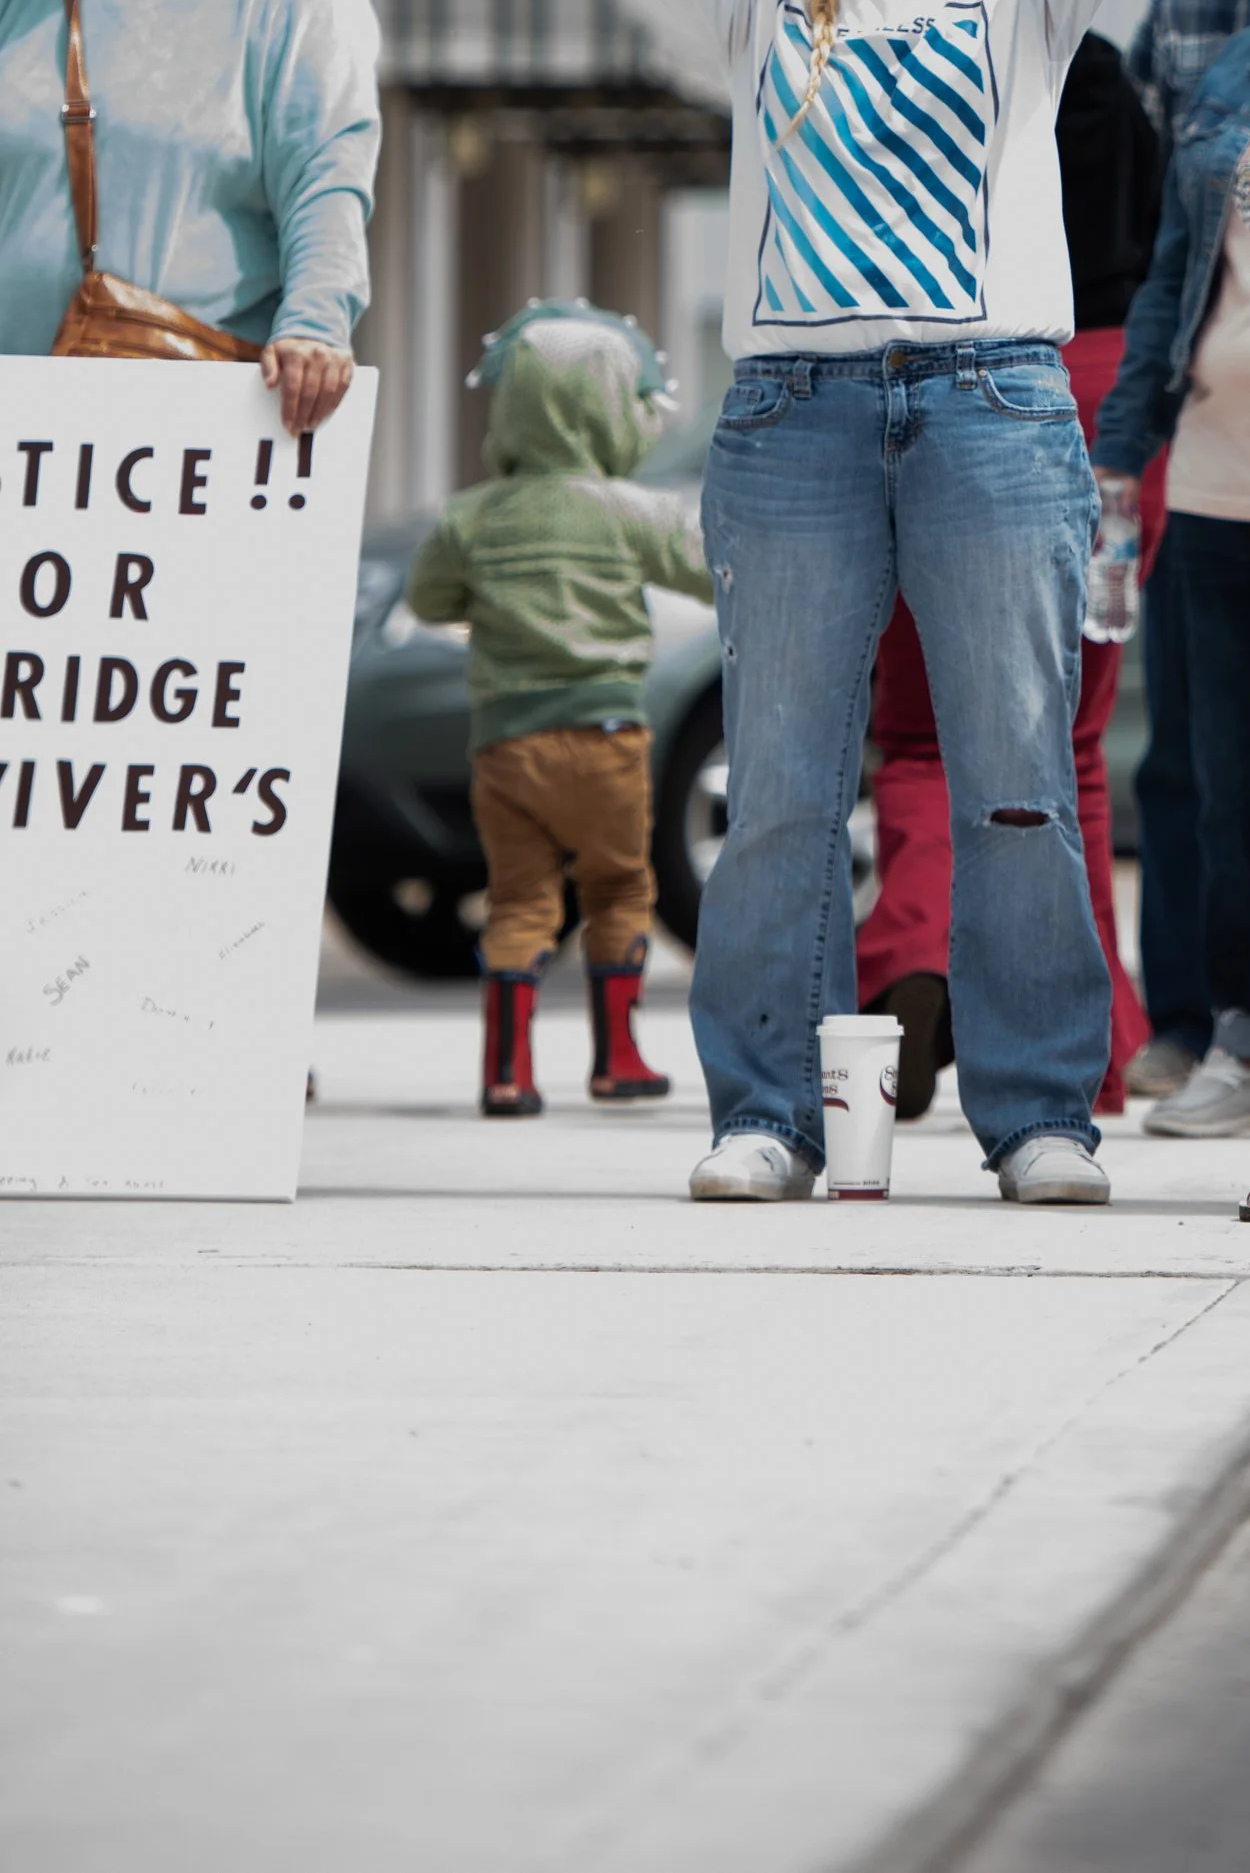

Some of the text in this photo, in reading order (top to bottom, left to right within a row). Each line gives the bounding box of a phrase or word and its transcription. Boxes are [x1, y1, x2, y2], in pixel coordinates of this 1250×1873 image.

[0, 440, 212, 516] TICE
[19, 550, 155, 622] OR
[0, 650, 246, 729] RIDGE
[42, 954, 91, 1007] SEAN
